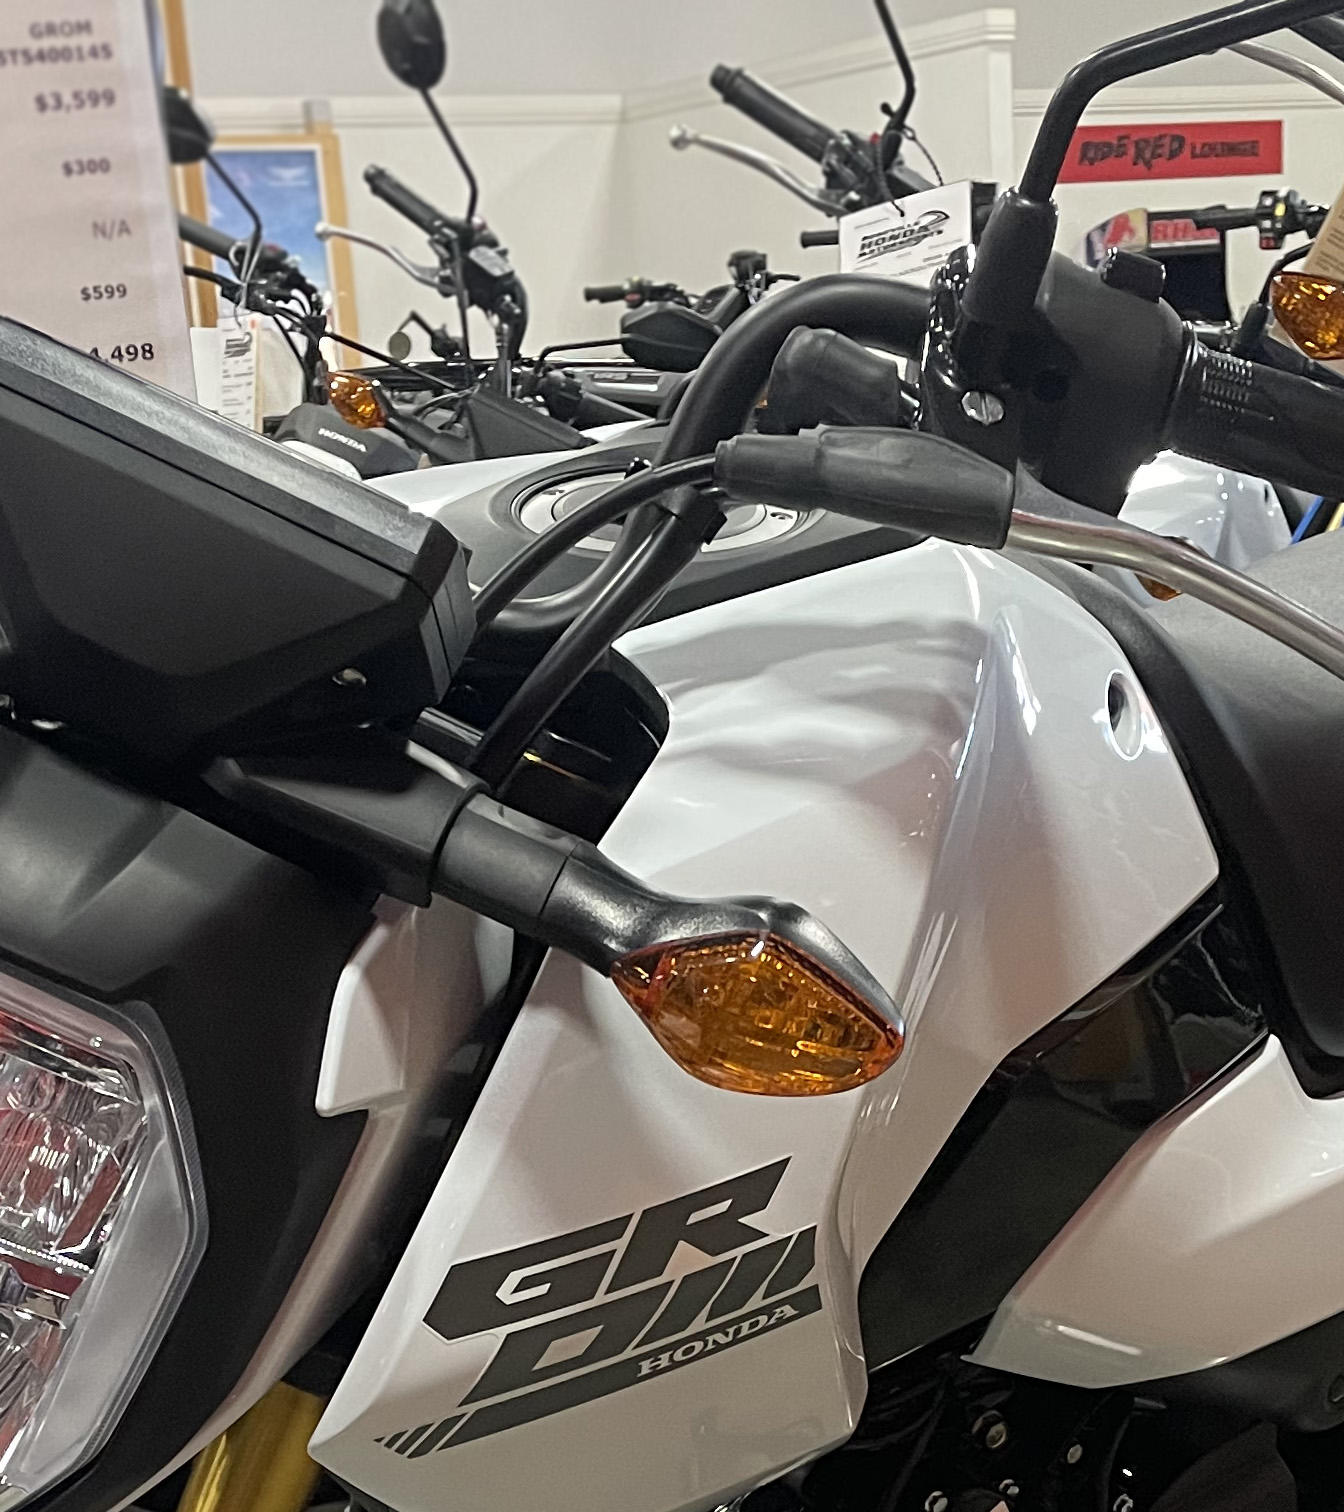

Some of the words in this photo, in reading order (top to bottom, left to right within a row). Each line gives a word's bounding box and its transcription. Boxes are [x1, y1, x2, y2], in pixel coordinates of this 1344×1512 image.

[28, 20, 93, 41] GROM
[34, 88, 117, 114] $3,599
[1132, 133, 1187, 171] RED
[61, 157, 112, 178] $300
[91, 219, 133, 240] N/A
[80, 284, 129, 302] $599
[318, 427, 368, 453] HONDA
[637, 1304, 800, 1378] HONDA
